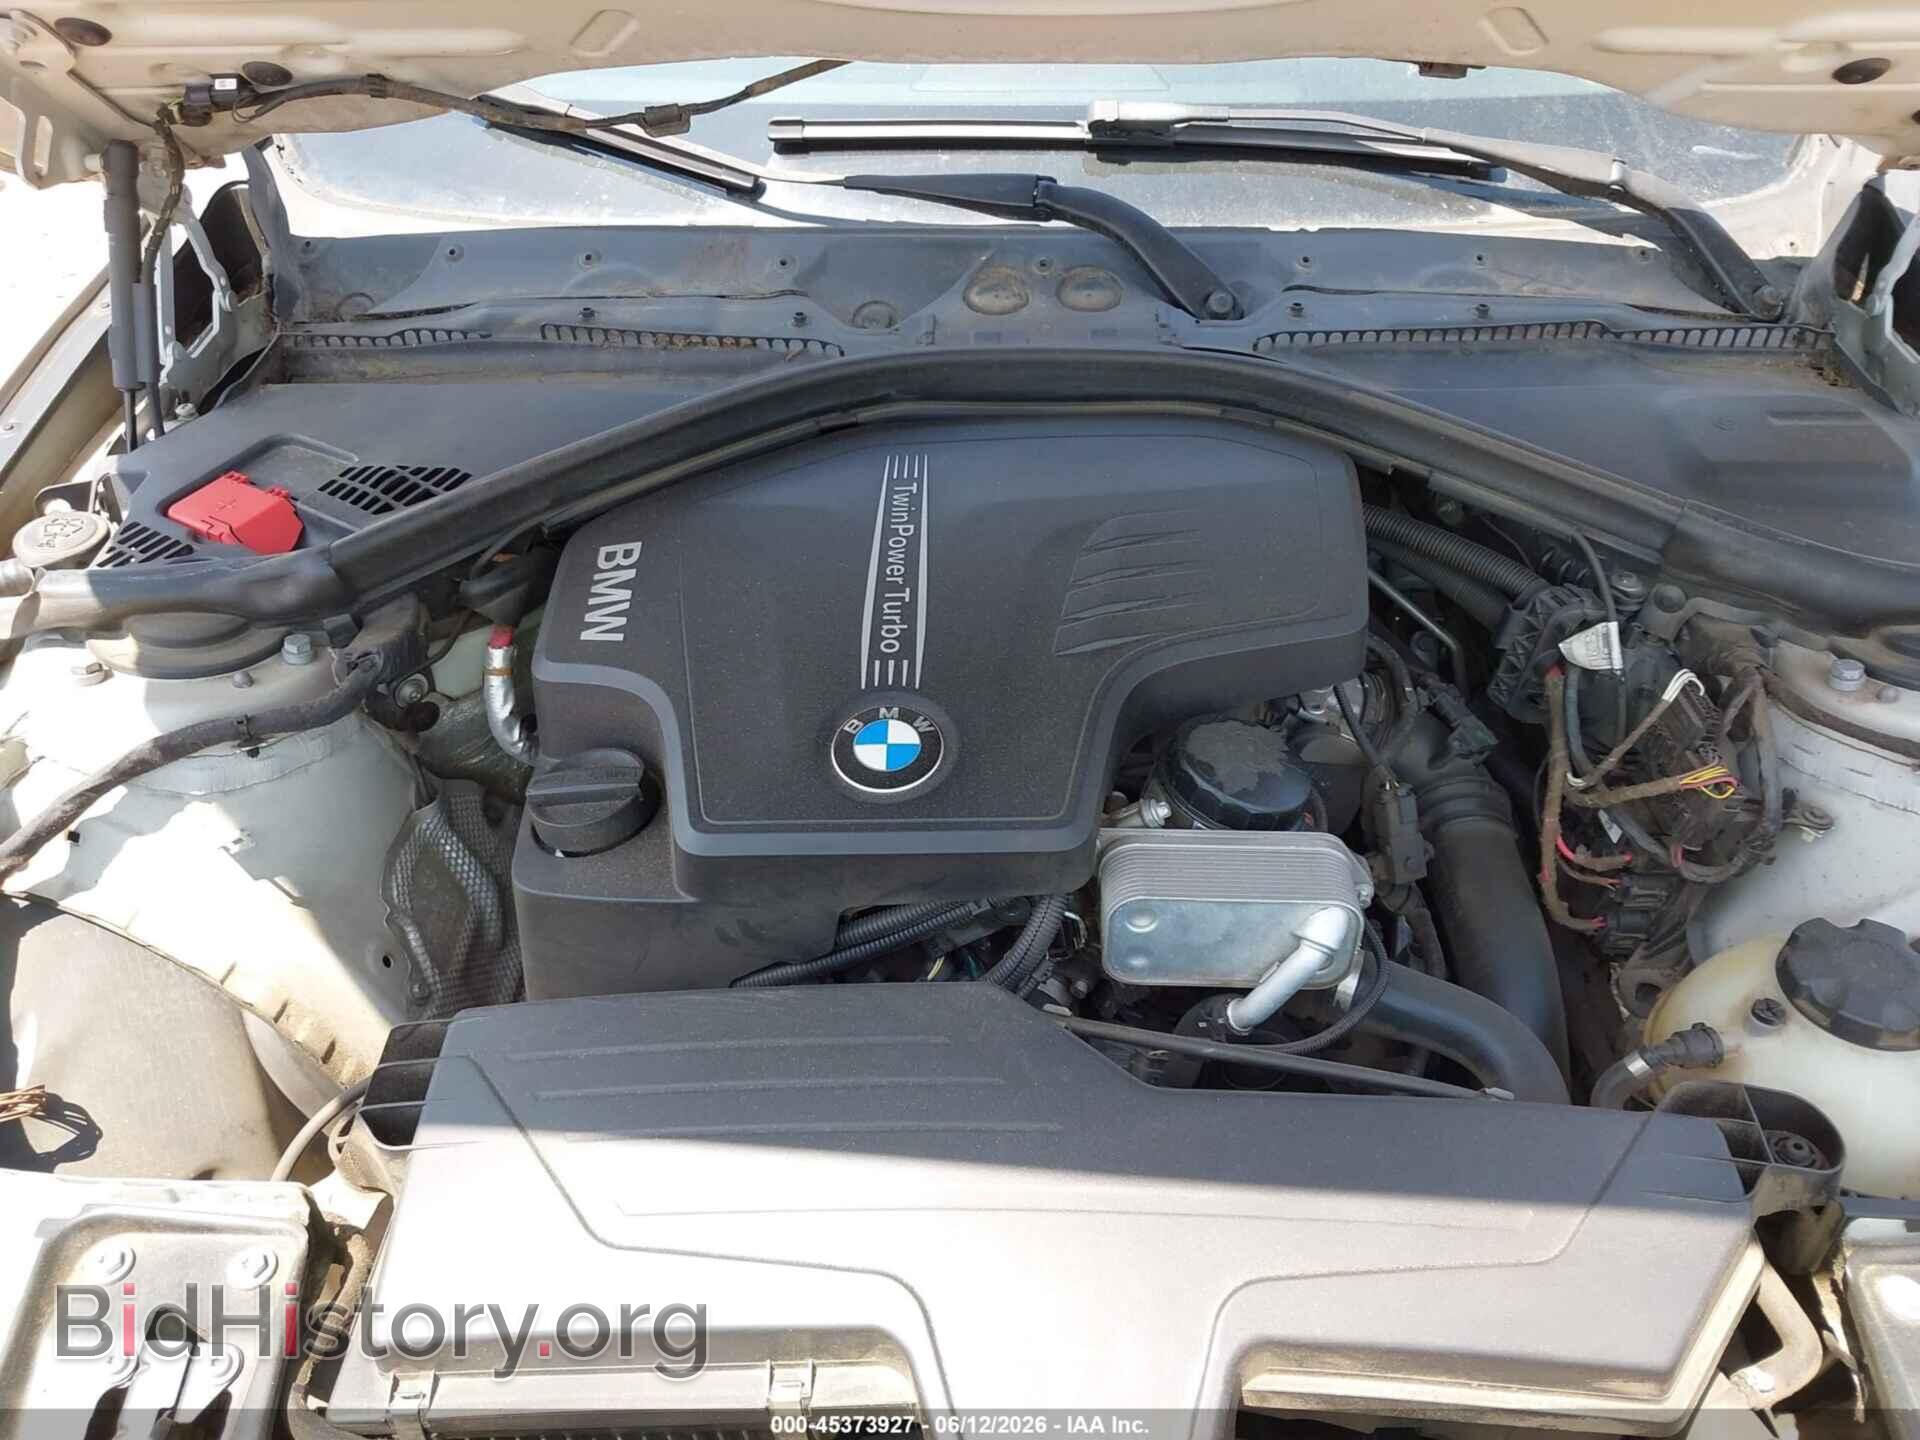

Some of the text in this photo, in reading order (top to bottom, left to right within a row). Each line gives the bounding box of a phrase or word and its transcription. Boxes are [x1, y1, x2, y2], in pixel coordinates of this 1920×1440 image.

[580, 541, 643, 641] BMW
[879, 482, 918, 654] TwinPower Turbo
[843, 706, 936, 735] BMW
